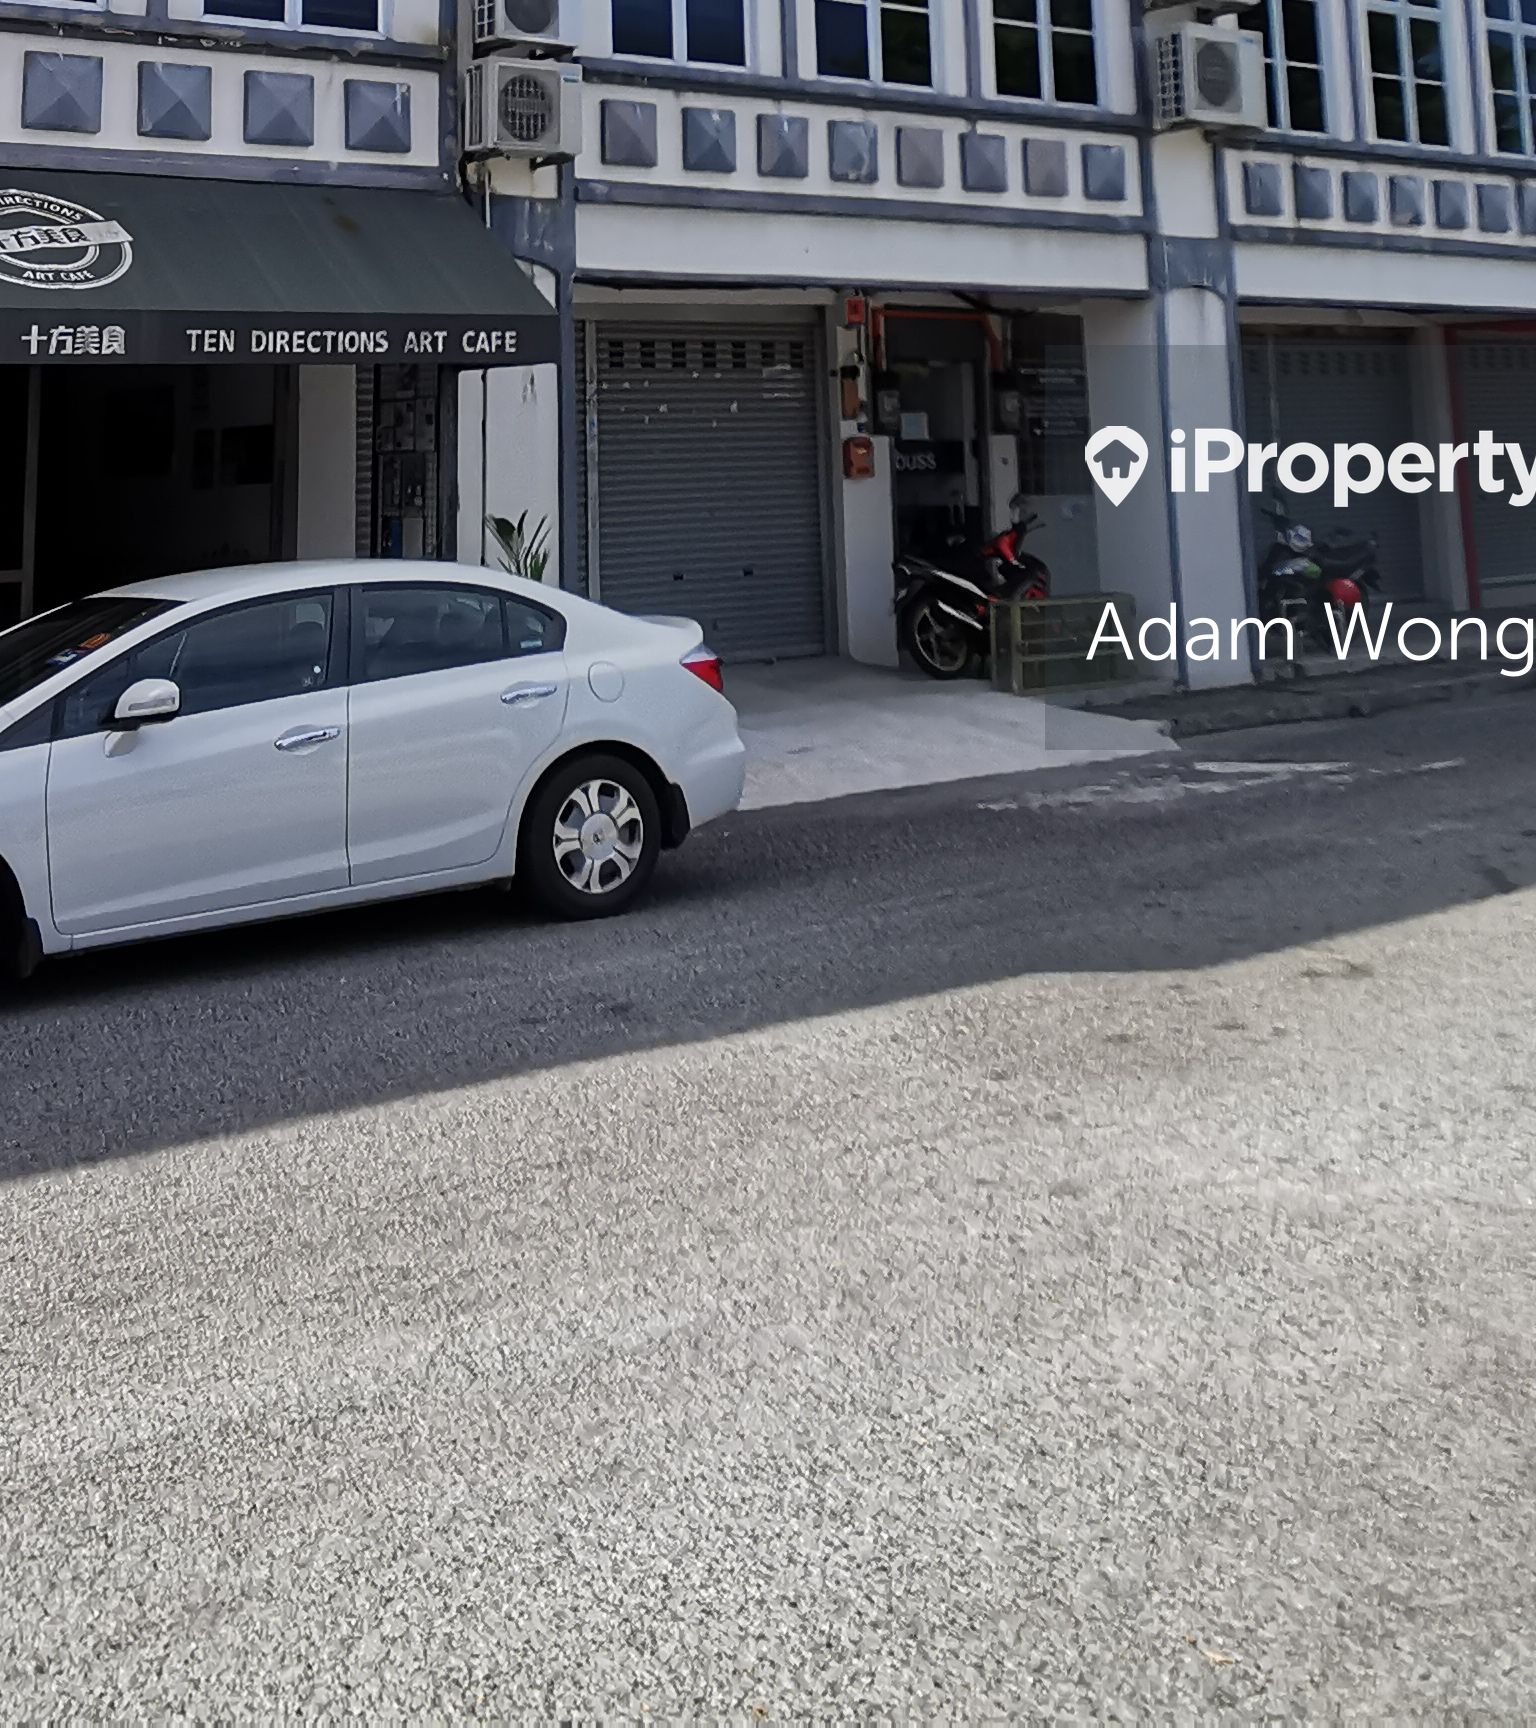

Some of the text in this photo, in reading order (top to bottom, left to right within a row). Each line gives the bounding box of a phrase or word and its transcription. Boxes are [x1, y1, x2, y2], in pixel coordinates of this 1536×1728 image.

[22, 270, 96, 282] ART CAFE
[21, 324, 127, 356] 十方美食
[186, 328, 518, 353] TEN DIRECTIONS ART CAFE
